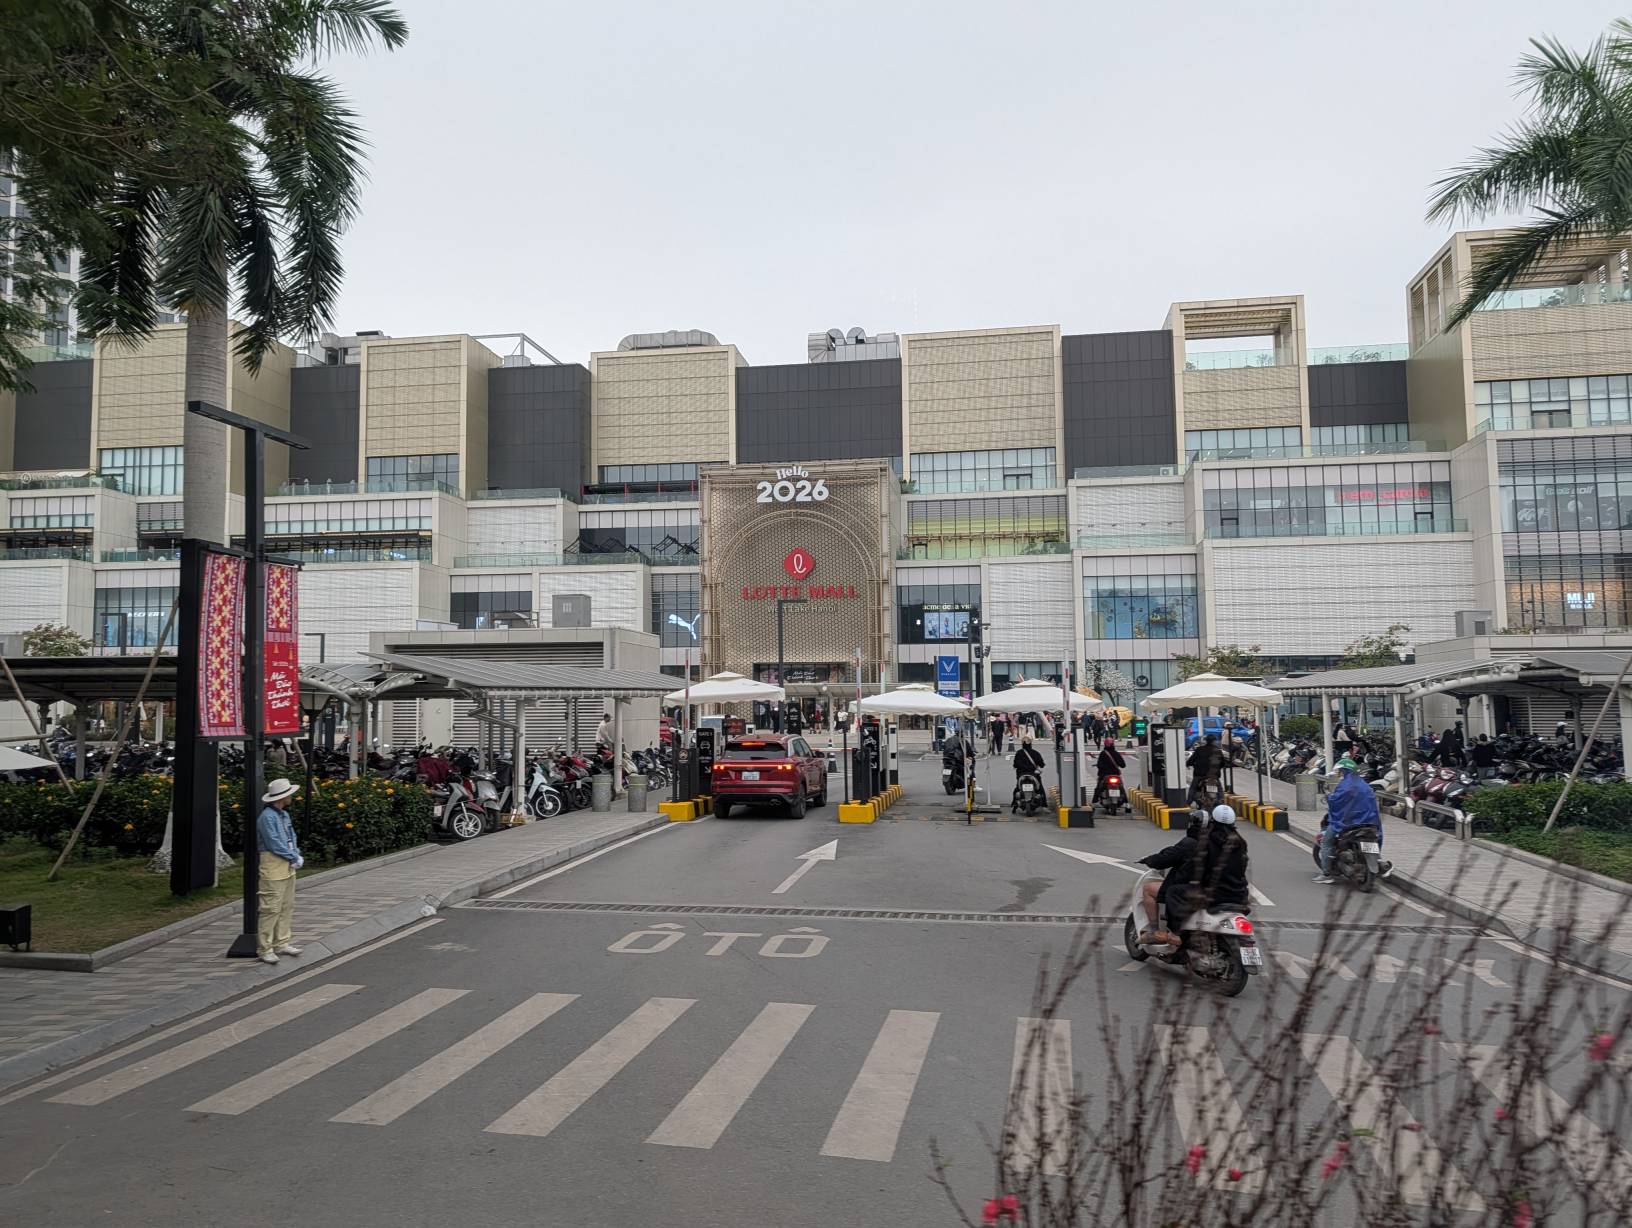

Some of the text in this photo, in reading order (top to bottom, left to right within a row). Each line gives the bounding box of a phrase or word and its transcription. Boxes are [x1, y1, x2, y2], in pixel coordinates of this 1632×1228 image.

[775, 465, 809, 480] Hello
[756, 480, 829, 503] 2026
[741, 583, 858, 600] LOTTE MALL
[790, 605, 811, 613] Lake
[606, 922, 832, 958] Ô TÔ
